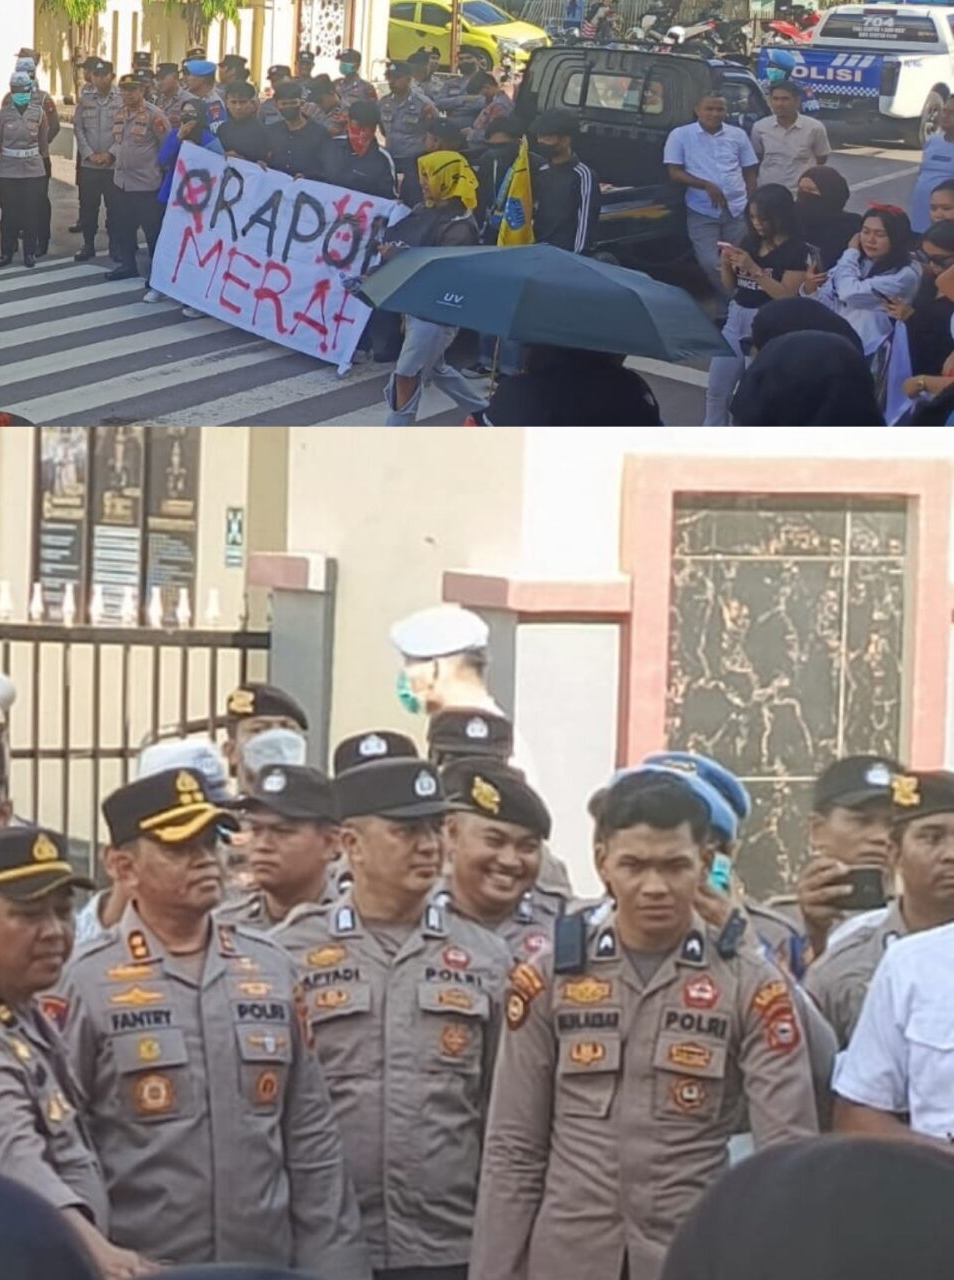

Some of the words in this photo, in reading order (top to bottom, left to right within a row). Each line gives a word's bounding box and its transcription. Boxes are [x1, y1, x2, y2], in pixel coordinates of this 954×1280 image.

[862, 16, 895, 28] 704
[791, 66, 862, 83] OLISI
[444, 292, 464, 304] UV
[425, 967, 483, 987] POLRI
[237, 1003, 286, 1019] POLRI
[664, 1011, 727, 1037] POLRI
